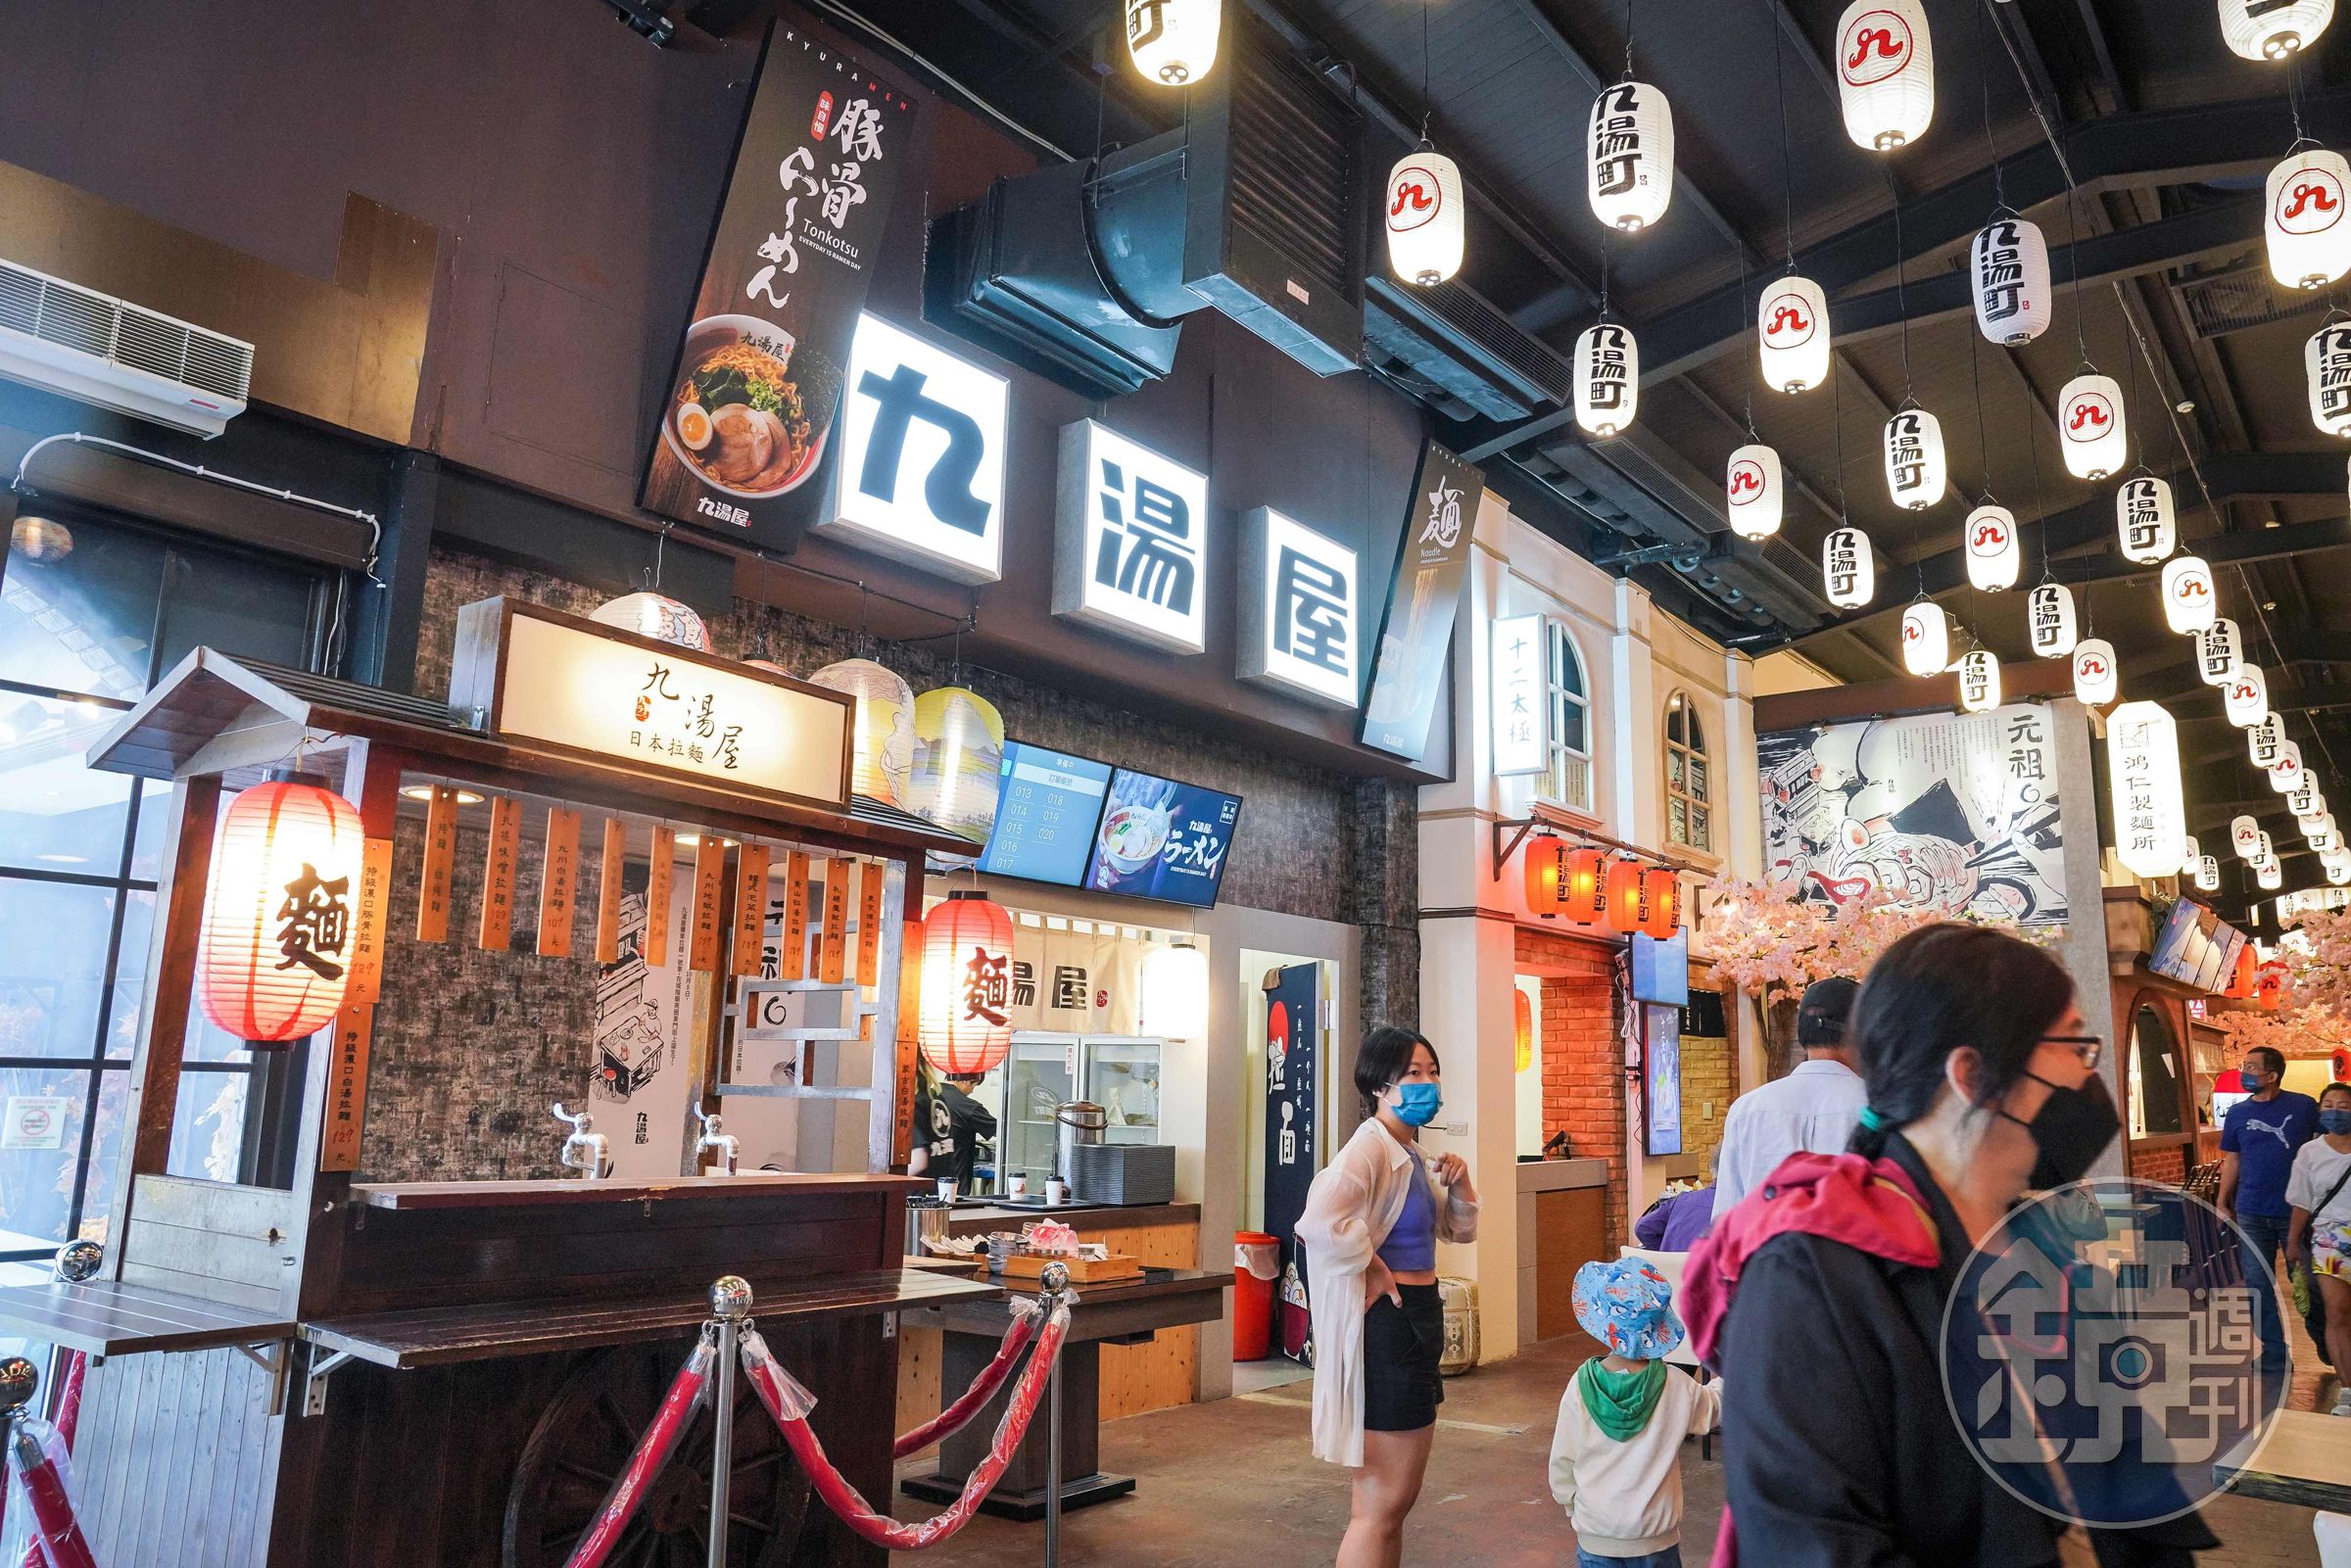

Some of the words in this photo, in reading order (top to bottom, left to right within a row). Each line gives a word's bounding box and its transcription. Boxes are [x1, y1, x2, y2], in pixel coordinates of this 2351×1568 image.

[786, 30, 908, 111] KYURAMEN
[821, 98, 885, 229] 豚骨
[1595, 84, 1643, 197] 九湯町
[798, 235, 826, 254] EVERYDAY
[832, 252, 850, 266] RAMEN
[850, 261, 862, 271] DAY
[803, 217, 859, 259] Tonkotsu
[1977, 221, 2025, 323] 九湯町
[740, 331, 786, 362] 九湯屋
[1589, 324, 1627, 410] 九湯町
[1889, 414, 1926, 493] 九湯町
[696, 497, 750, 528] 九湯屋
[857, 363, 1350, 678] 九湯屋
[1418, 475, 1465, 548] 麵
[2125, 480, 2161, 550] 九湯町
[1829, 531, 1858, 595] 九湯町
[2034, 588, 2062, 647] 九湯町
[1509, 638, 1532, 745] 十二太極
[1965, 652, 1989, 702] 九湯町
[642, 662, 744, 770] 九湯屋
[630, 731, 704, 764] 日本拉麵
[1010, 803, 1028, 817] 014
[1015, 786, 1032, 798] 013
[1001, 839, 1019, 852] 016
[1006, 822, 1023, 834] 015
[1038, 828, 1055, 840] 020
[1164, 829, 1226, 869] ラーメン
[996, 858, 1014, 870] 017
[274, 862, 350, 982] 麵
[962, 946, 1014, 1027] 麵
[635, 1112, 648, 1144] 九湯屋
